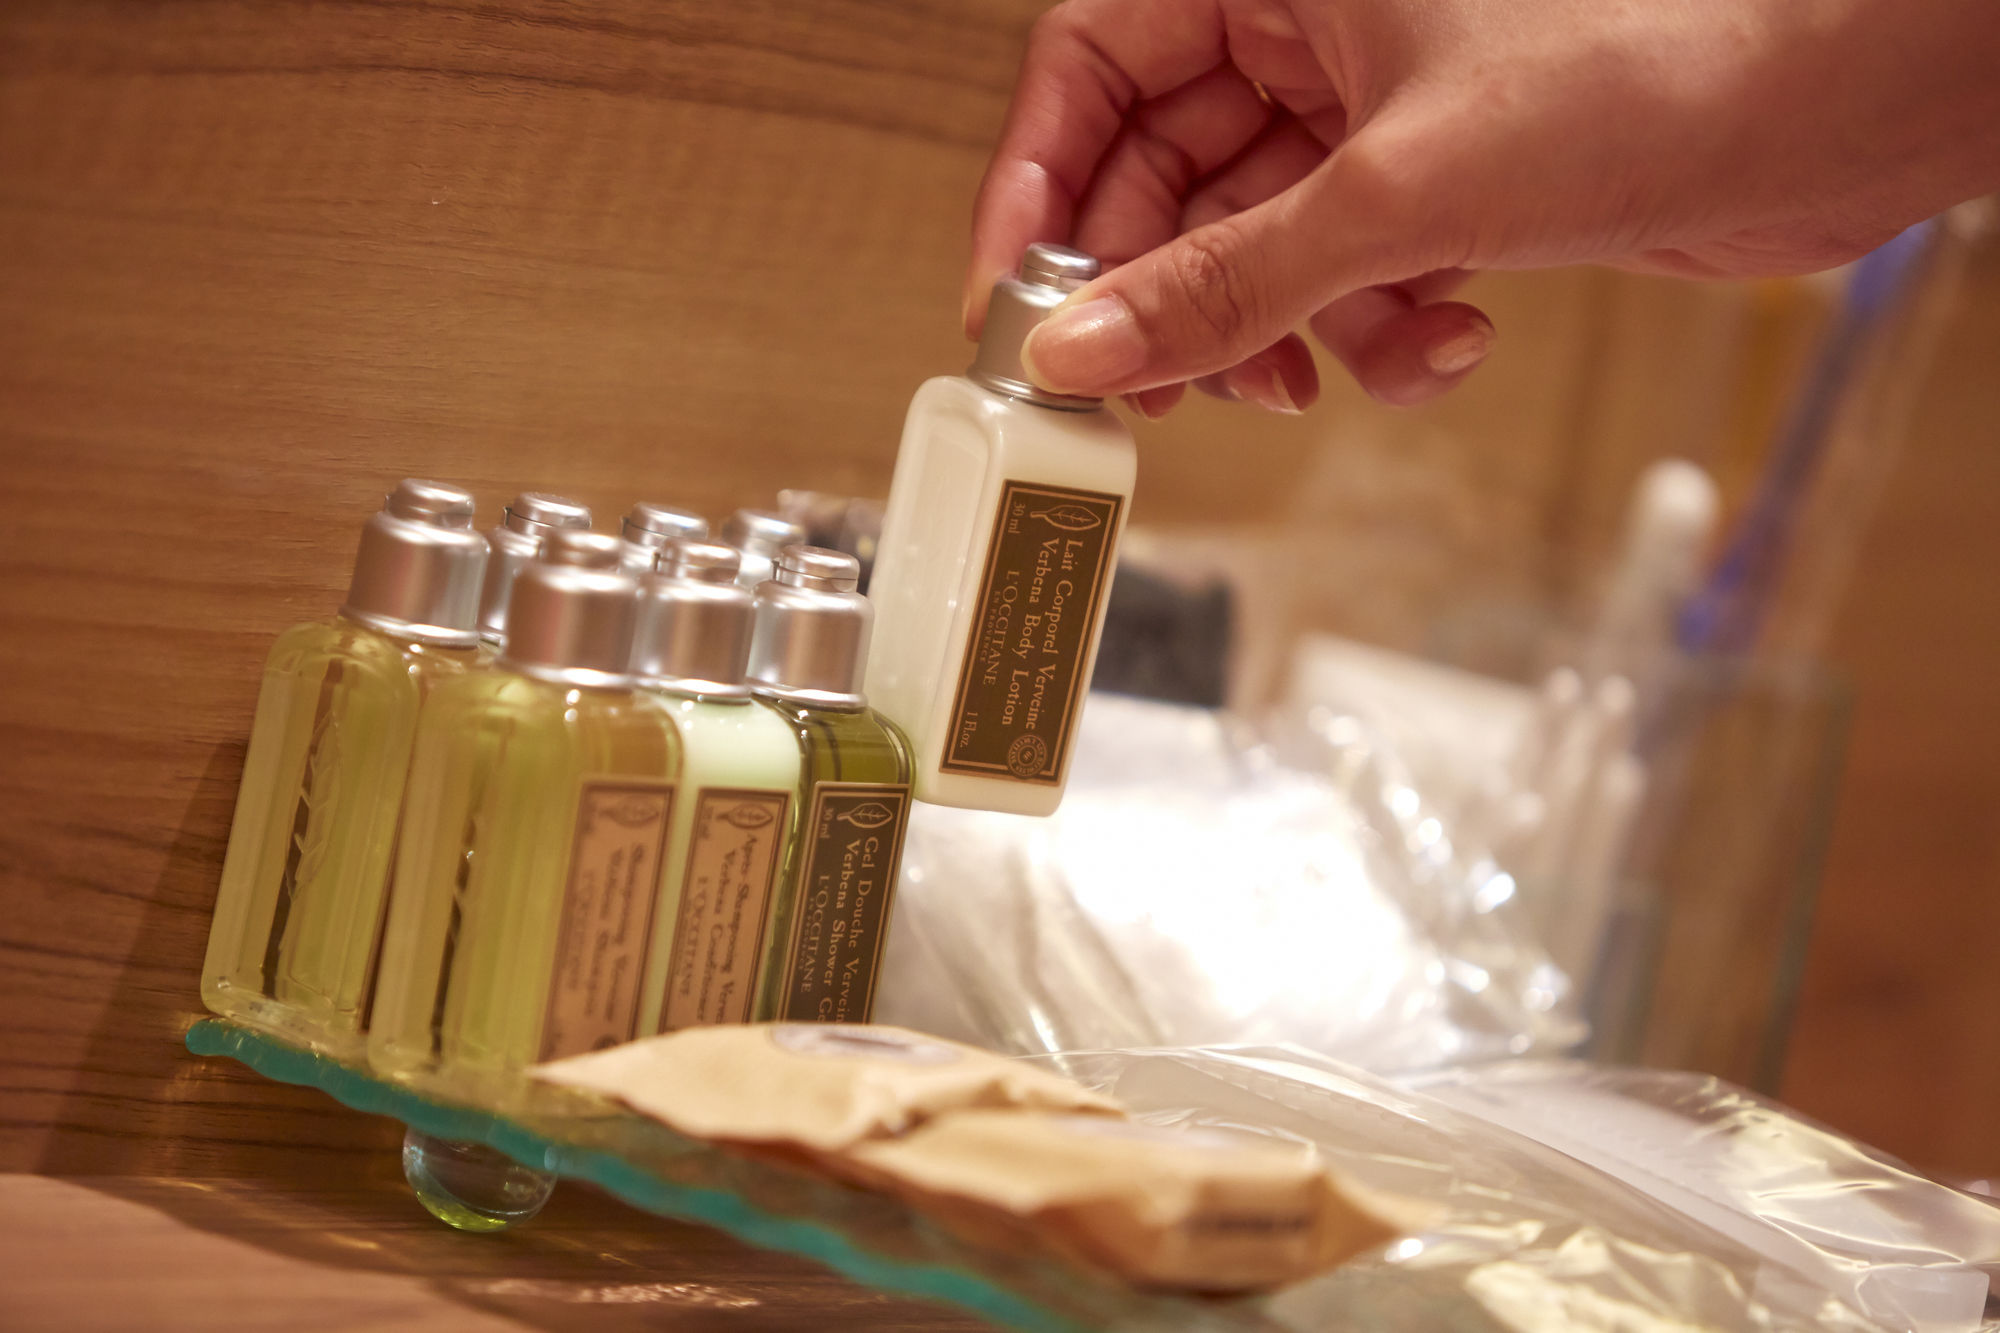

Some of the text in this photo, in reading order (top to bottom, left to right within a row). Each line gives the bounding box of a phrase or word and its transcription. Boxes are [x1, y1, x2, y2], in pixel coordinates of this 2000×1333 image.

[1008, 502, 1025, 533] 30 ml
[1029, 538, 1059, 603] Verbena
[1061, 539, 1083, 570] Lait
[1012, 614, 1041, 659] Body
[1043, 580, 1073, 654] Corporel
[1002, 670, 1029, 724] Lotion
[1026, 664, 1056, 729] Verveine
[816, 840, 860, 1023] Verbena Shower Ge
[834, 837, 878, 1024] Gel Douche Vervein
